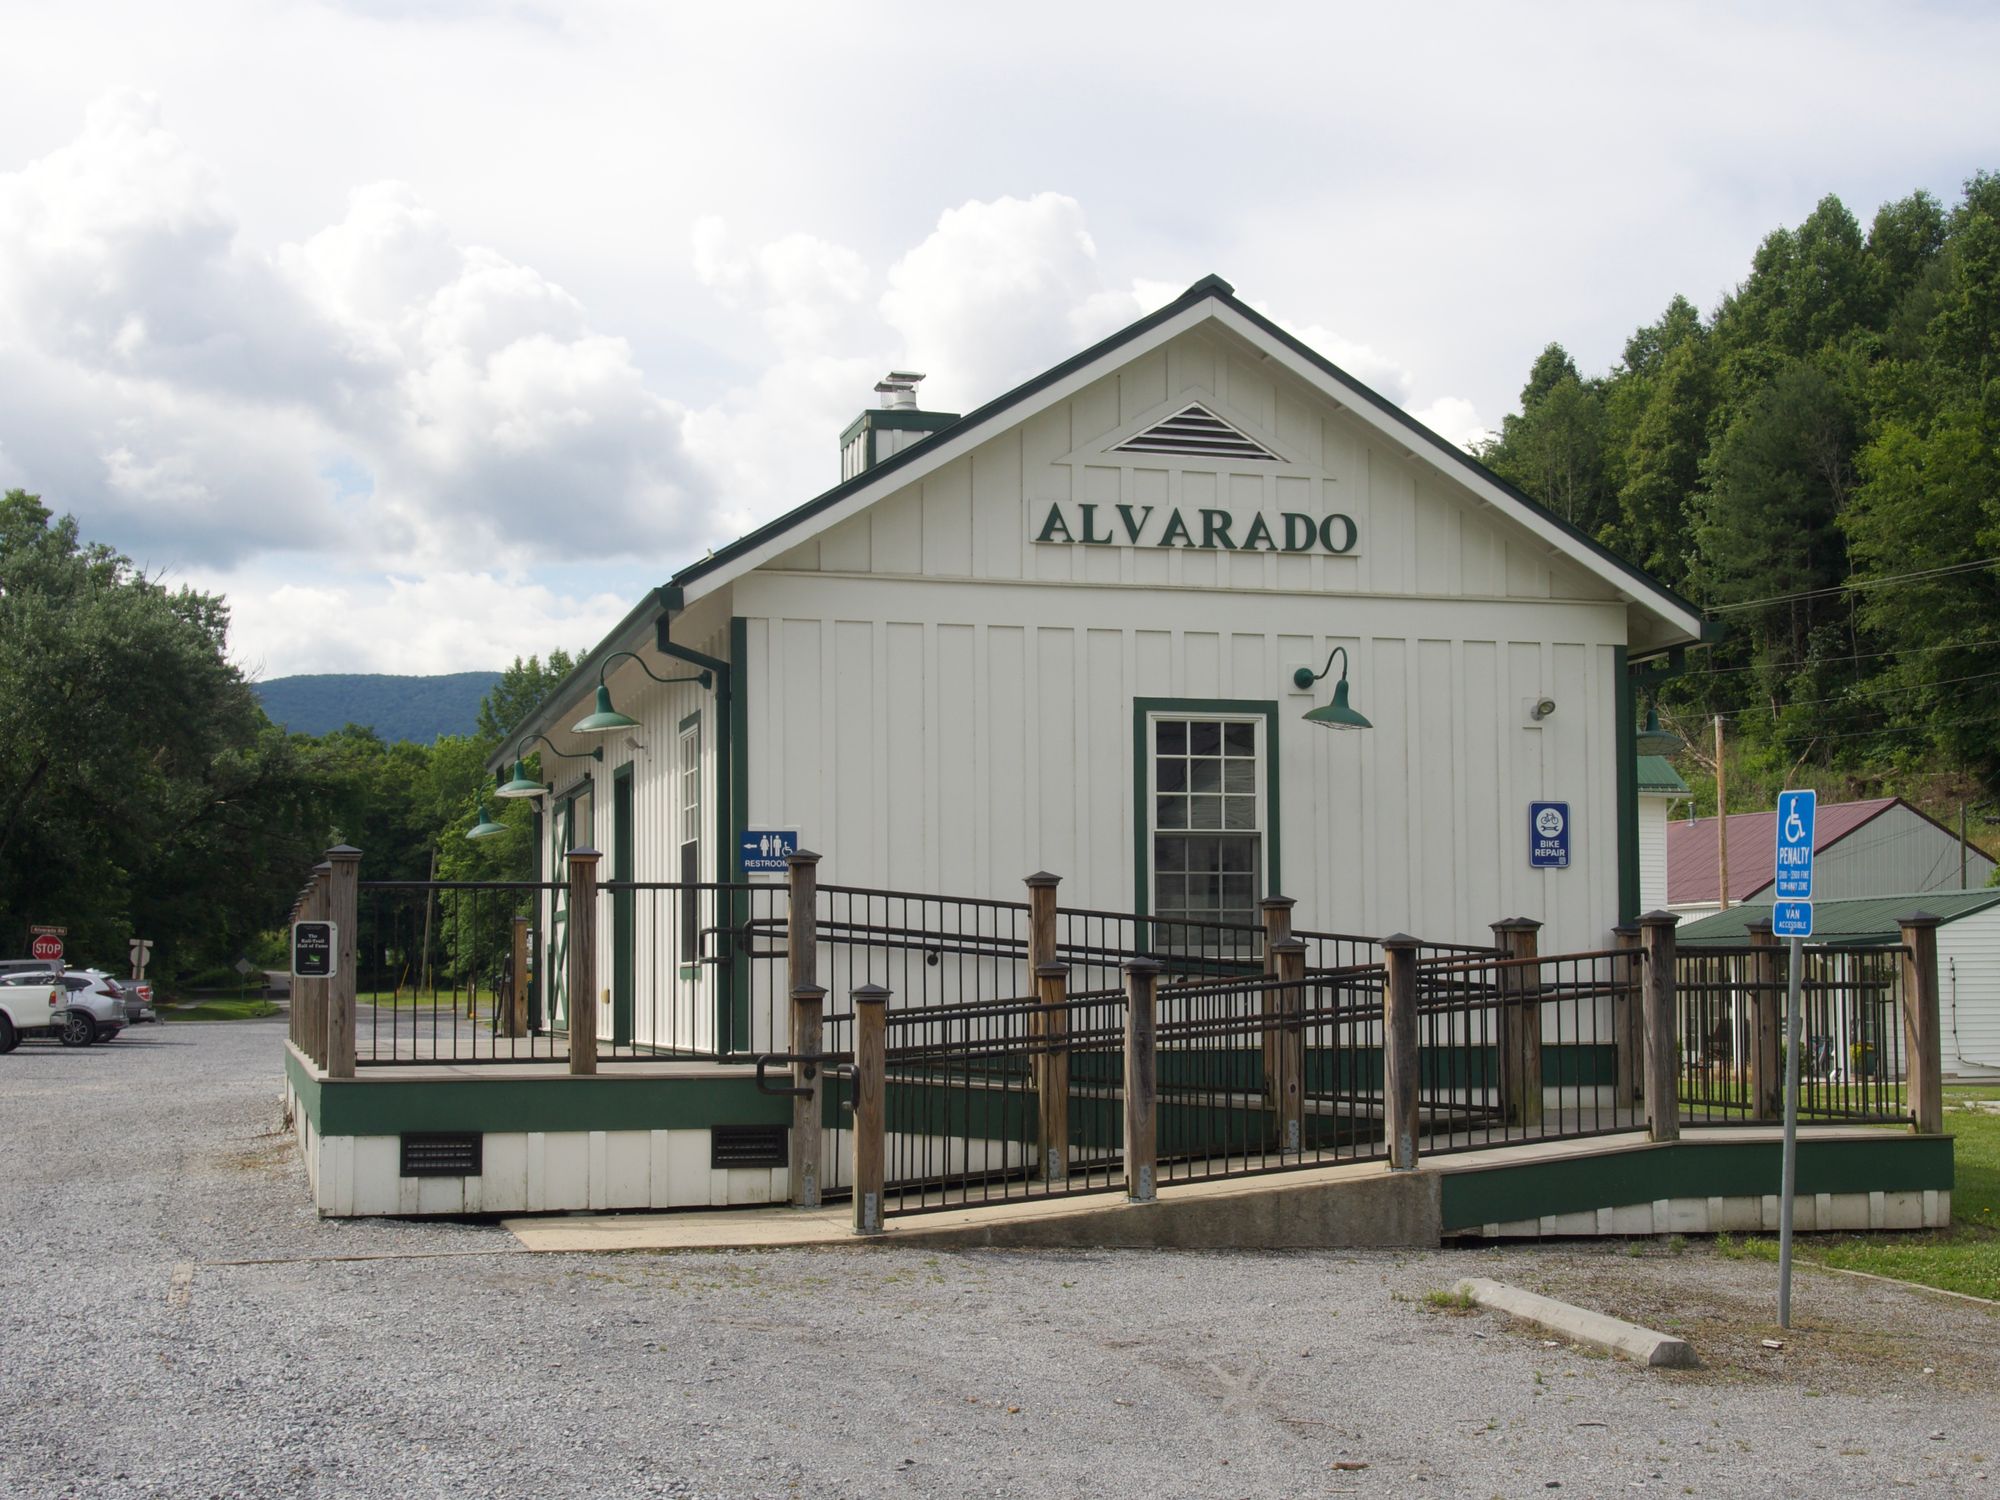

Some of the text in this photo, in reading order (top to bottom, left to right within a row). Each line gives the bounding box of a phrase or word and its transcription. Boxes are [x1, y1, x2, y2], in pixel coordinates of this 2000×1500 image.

[1035, 501, 1358, 553] ALVARADO
[1540, 840, 1560, 848] BIKE
[1535, 848, 1565, 857] REPAIR
[1779, 846, 1810, 865] PENALTY
[1785, 908, 1800, 919] VAN
[1778, 921, 1807, 929] ACCESSIBLE
[35, 943, 61, 954] STOP
